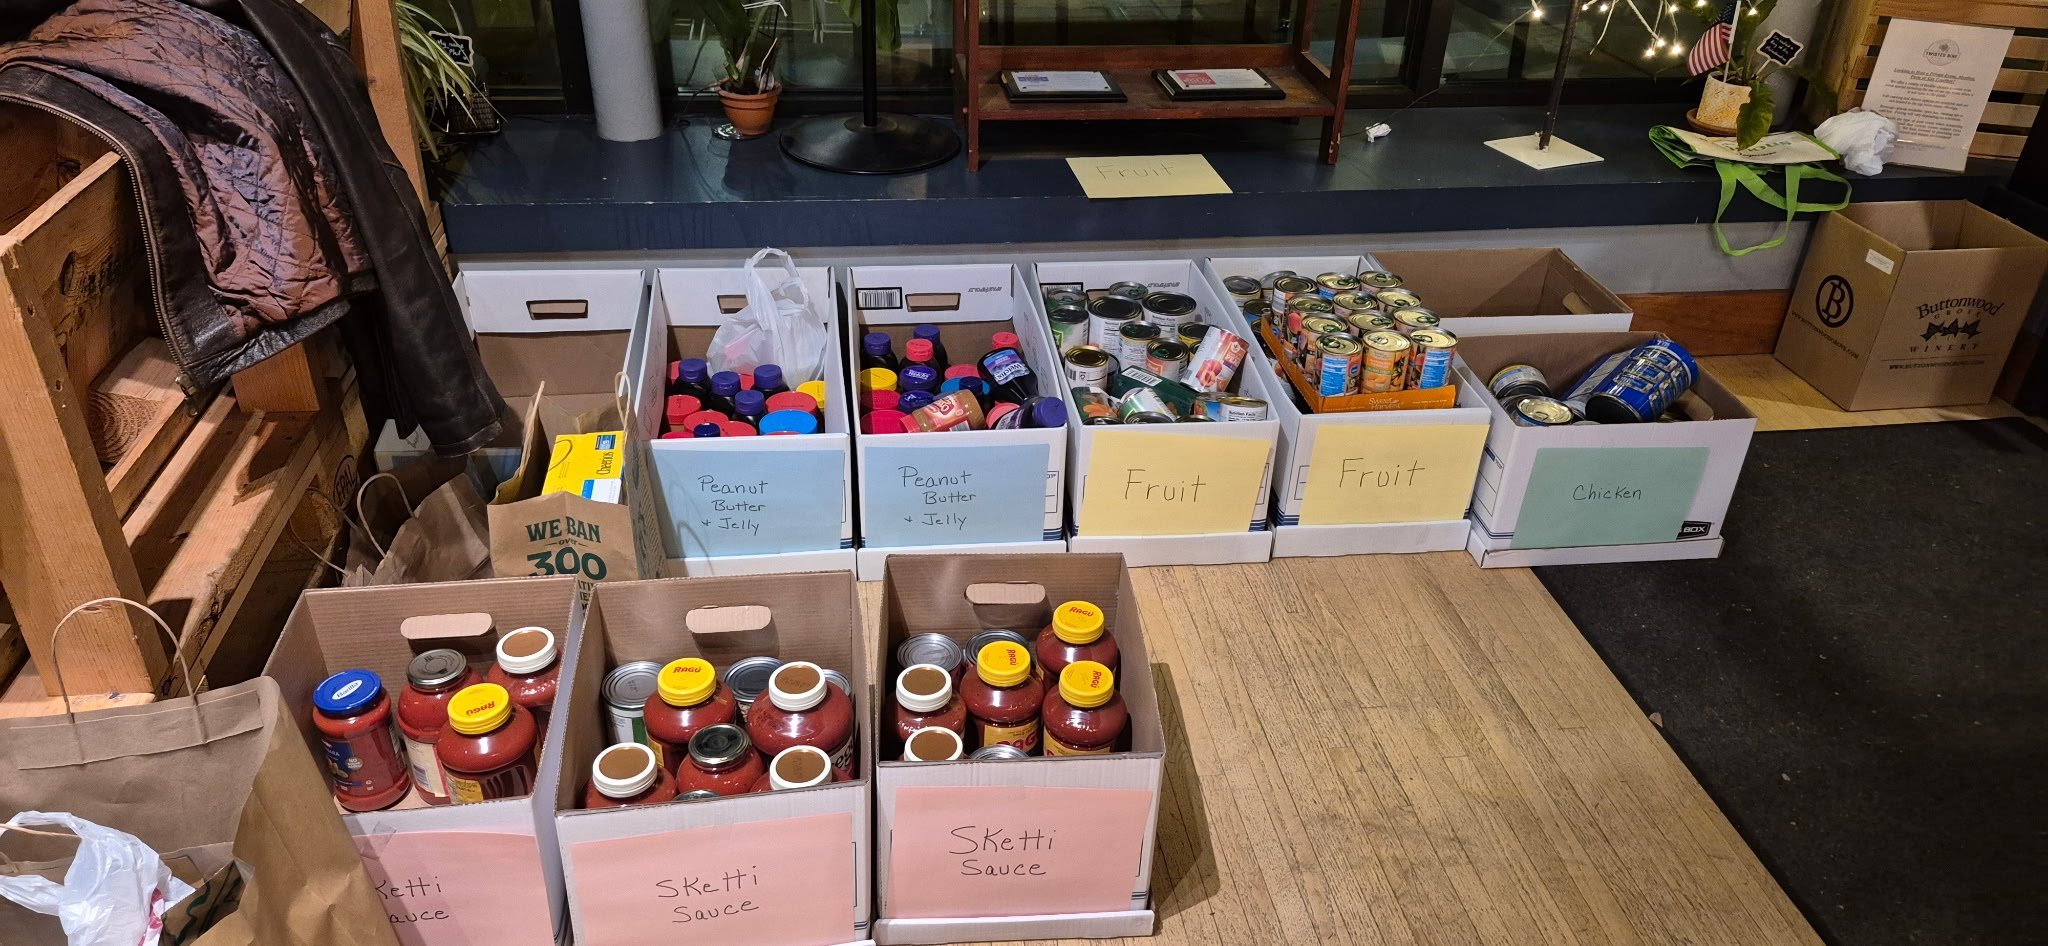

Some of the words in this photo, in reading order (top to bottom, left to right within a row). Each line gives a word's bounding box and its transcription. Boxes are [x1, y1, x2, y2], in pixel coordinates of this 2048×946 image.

[1095, 163, 1177, 180] Fruit
[1918, 297, 2005, 319] Buttonwood
[1910, 343, 1979, 353] WINERY
[897, 465, 972, 488] Peanut
[1338, 456, 1426, 489] Fruit
[698, 474, 769, 495] Peanut
[1124, 468, 1207, 502] Fruit
[1572, 483, 1642, 501] Chicken
[712, 499, 766, 513] Butter
[923, 491, 977, 505] Butter
[525, 518, 563, 542] WE
[566, 516, 602, 543] BAN
[719, 517, 760, 536] Jelly
[921, 512, 967, 530] Jelly
[527, 547, 607, 580] 300
[336, 682, 359, 698] Barilla
[960, 859, 1048, 877] Sauce
[374, 876, 442, 899] ketti
[389, 910, 450, 924] auce
[671, 900, 760, 923] Sauce
